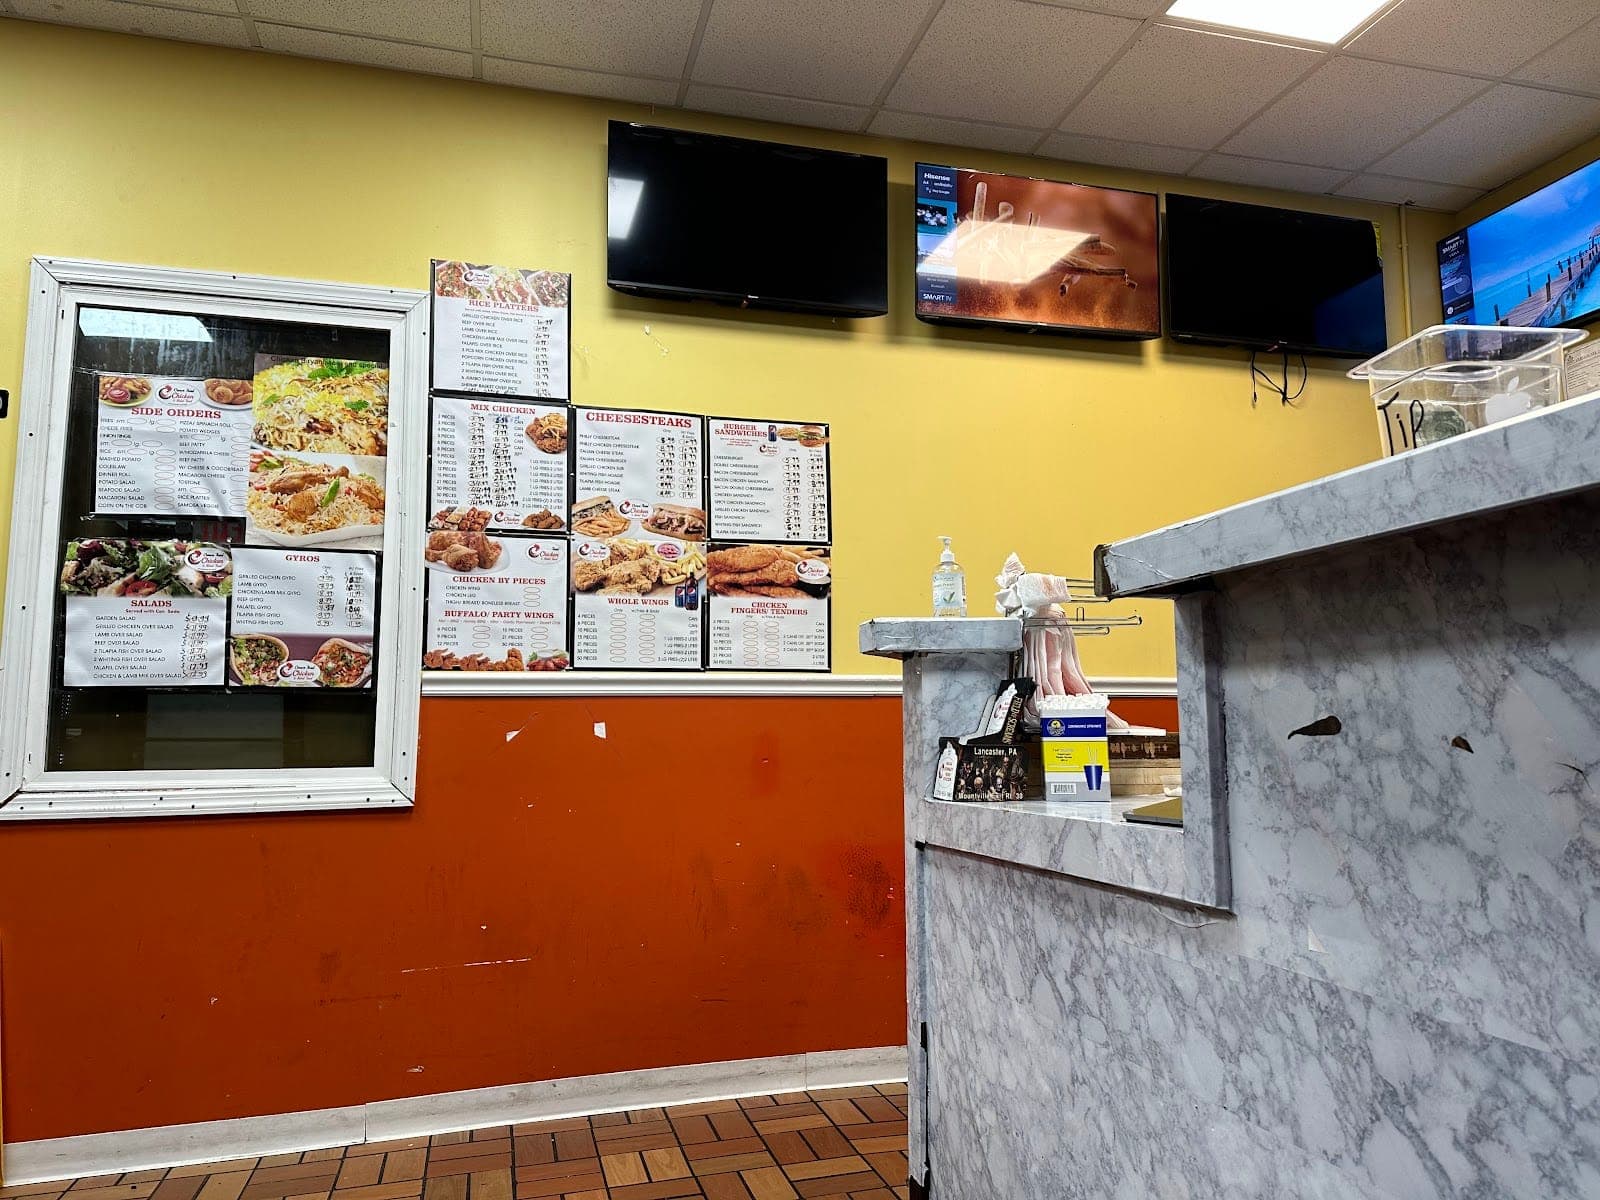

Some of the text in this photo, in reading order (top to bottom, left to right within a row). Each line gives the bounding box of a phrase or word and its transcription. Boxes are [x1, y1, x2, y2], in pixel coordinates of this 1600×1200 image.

[924, 172, 950, 180] Hisense
[469, 300, 539, 312] RICE PLATTERS
[131, 408, 222, 418] SIDE ORDERS
[492, 406, 536, 414] CHICKEN
[586, 412, 692, 428] CHEESESTEAKS
[714, 428, 768, 438] SANDWICHES
[286, 554, 320, 562] GYROS
[731, 607, 768, 615] FINGERS/
[974, 747, 1018, 757] Lancaster, PA
